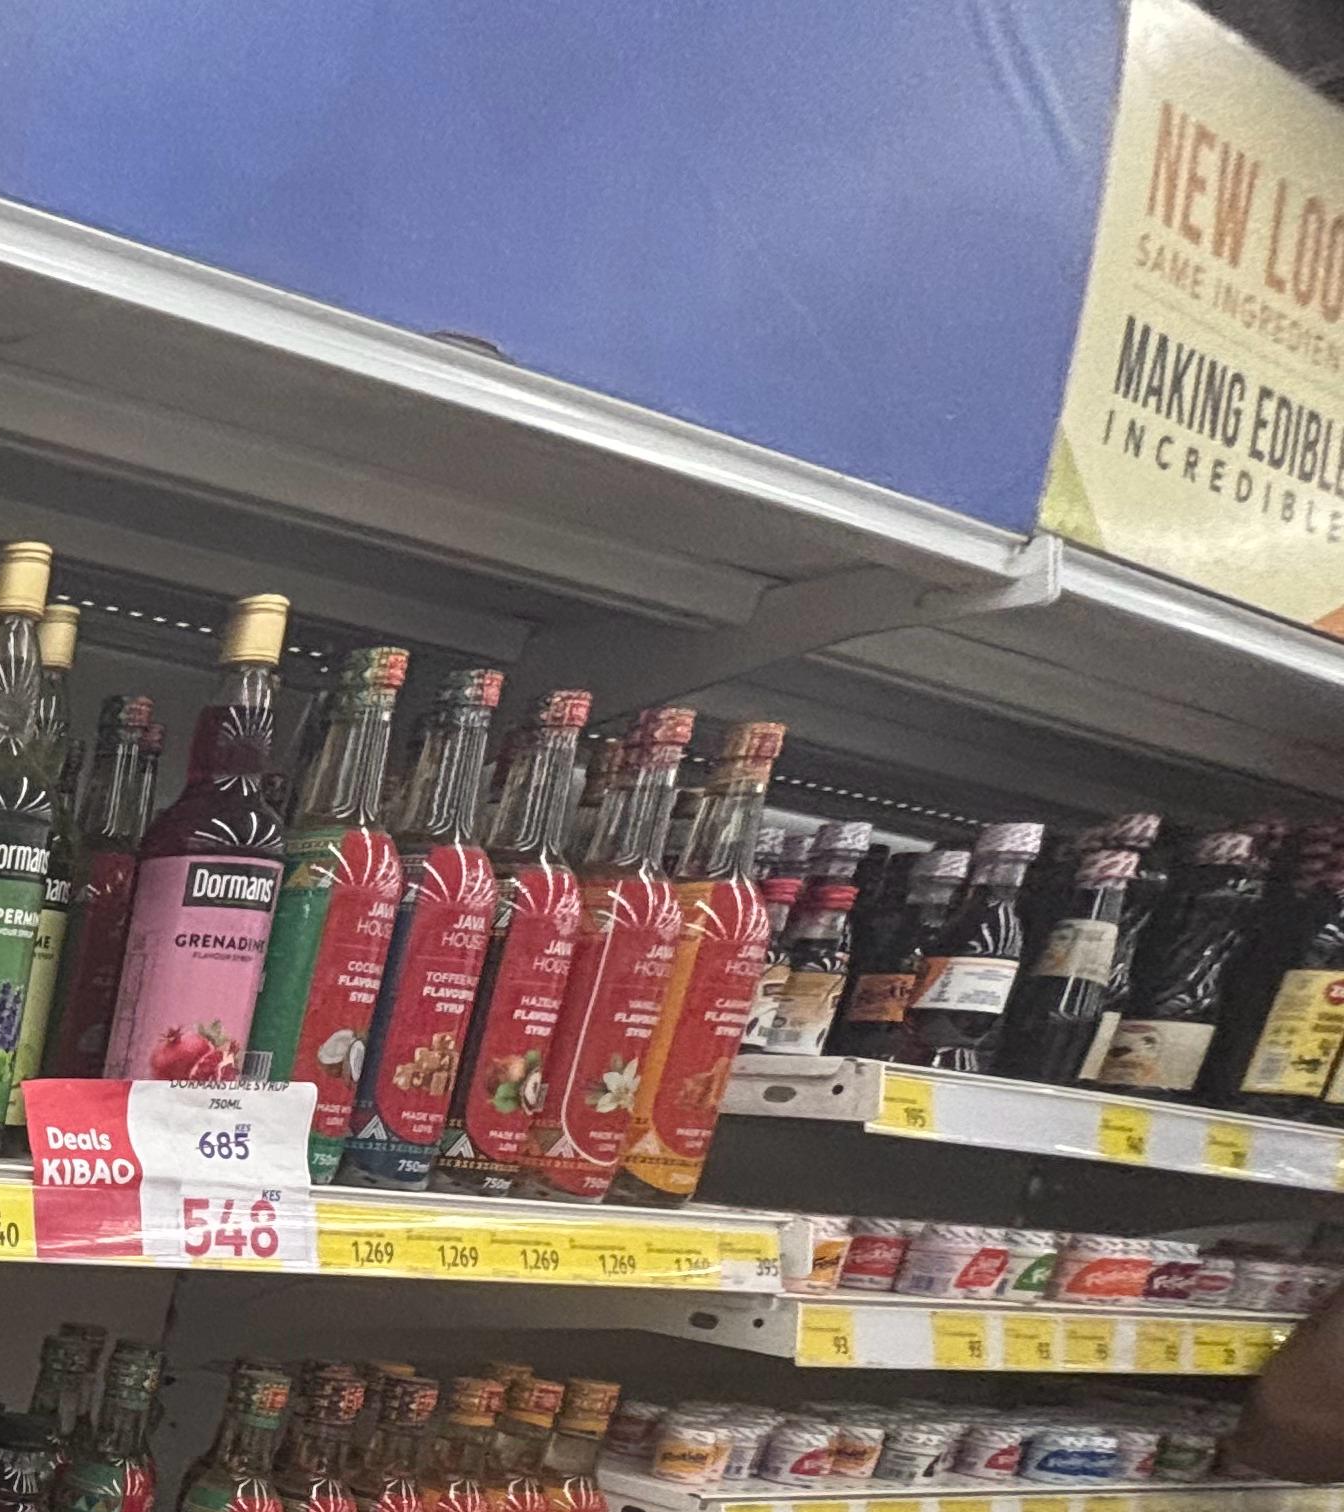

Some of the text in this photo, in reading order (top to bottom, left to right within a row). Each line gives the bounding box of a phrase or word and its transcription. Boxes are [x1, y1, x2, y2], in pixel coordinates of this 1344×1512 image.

[1146, 100, 1260, 269] NEW
[1135, 232, 1205, 301] SAME
[1113, 315, 1246, 448] MAKING
[1102, 408, 1342, 543] INCREDIBLE
[193, 869, 274, 903] Dormans
[208, 1098, 242, 1110] 750ML
[46, 1127, 112, 1151] Deals
[199, 1132, 250, 1160] 685
[42, 1158, 135, 1185] KIBAO
[262, 1189, 281, 1201] KES
[352, 1241, 394, 1266] 1,269
[438, 1244, 478, 1270] 1,269
[520, 1248, 559, 1272] 1,269
[598, 1253, 636, 1275] 1,269
